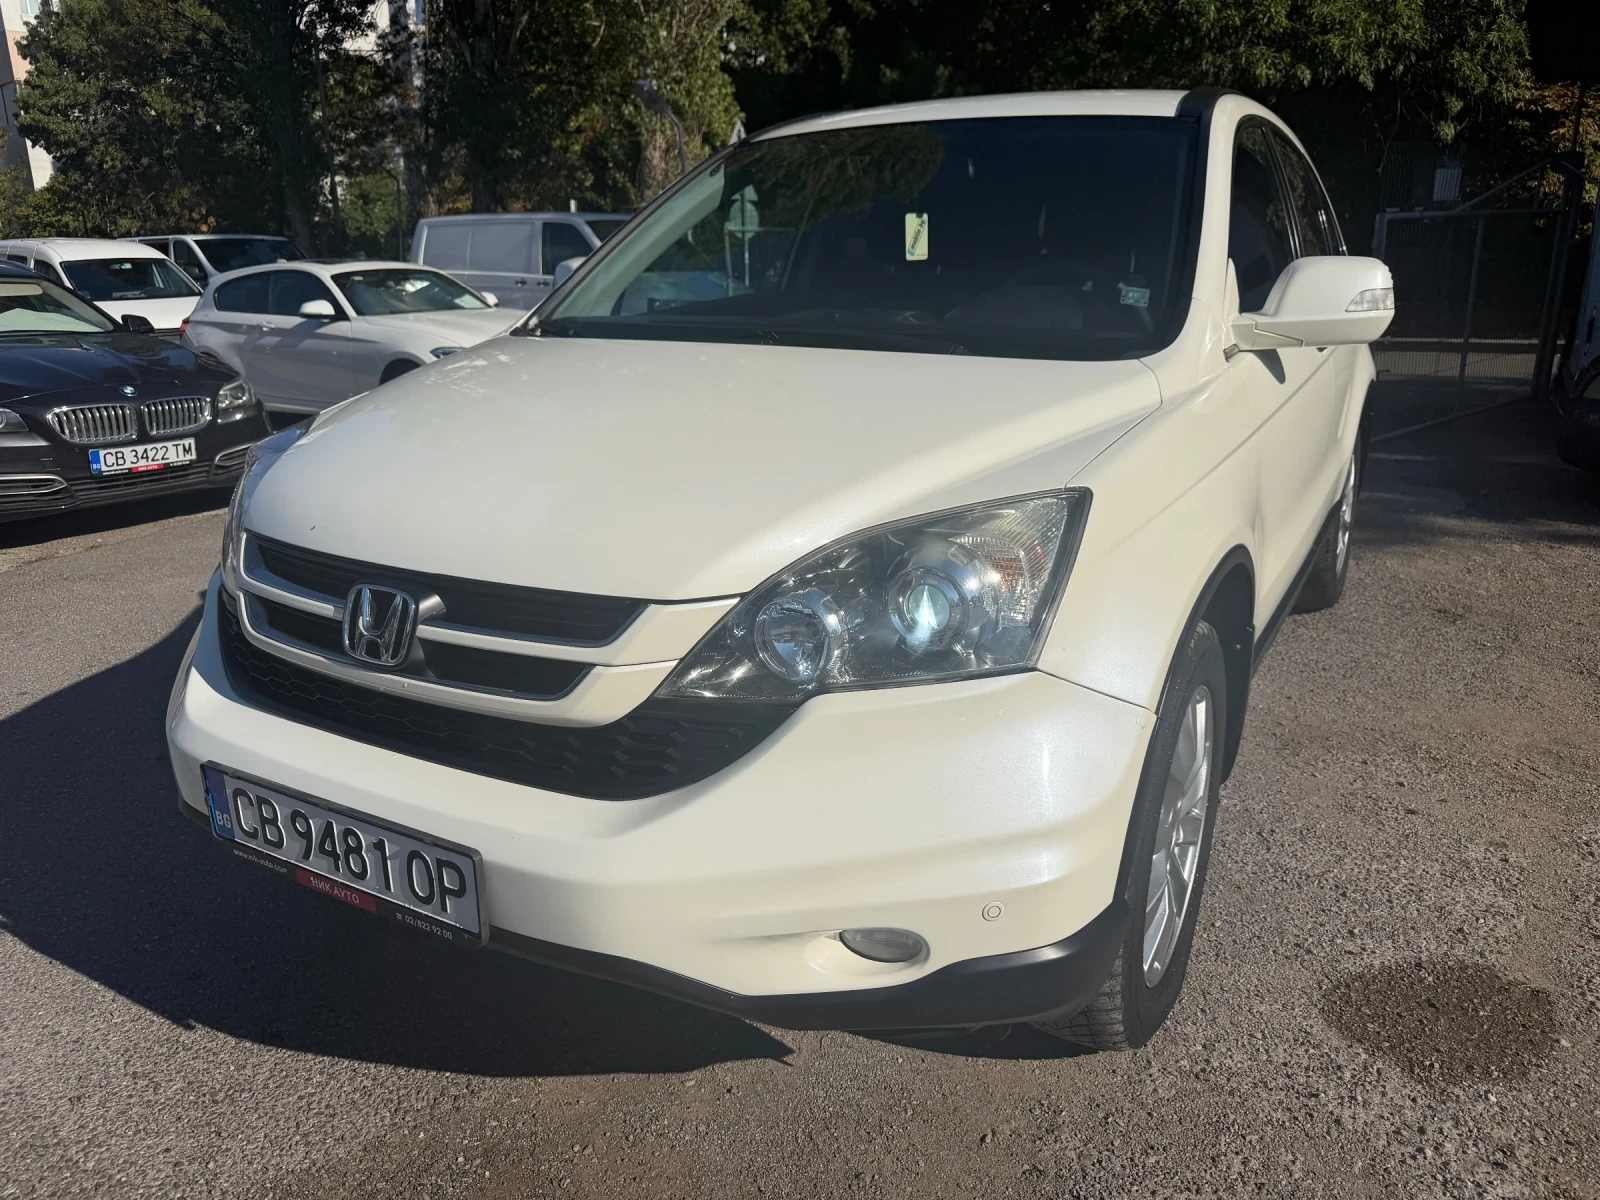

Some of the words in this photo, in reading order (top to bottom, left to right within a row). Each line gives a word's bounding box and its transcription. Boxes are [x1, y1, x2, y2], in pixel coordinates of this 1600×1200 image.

[103, 451, 126, 468] CB
[130, 445, 170, 464] 3422
[172, 441, 193, 459] TM
[215, 809, 232, 829] BG
[232, 787, 287, 850] CB
[290, 808, 394, 893] 9481
[406, 849, 466, 914] OP
[333, 886, 360, 904] АУТО
[404, 914, 431, 931] 02/822
[431, 925, 442, 936] 92
[442, 929, 453, 940] 00
